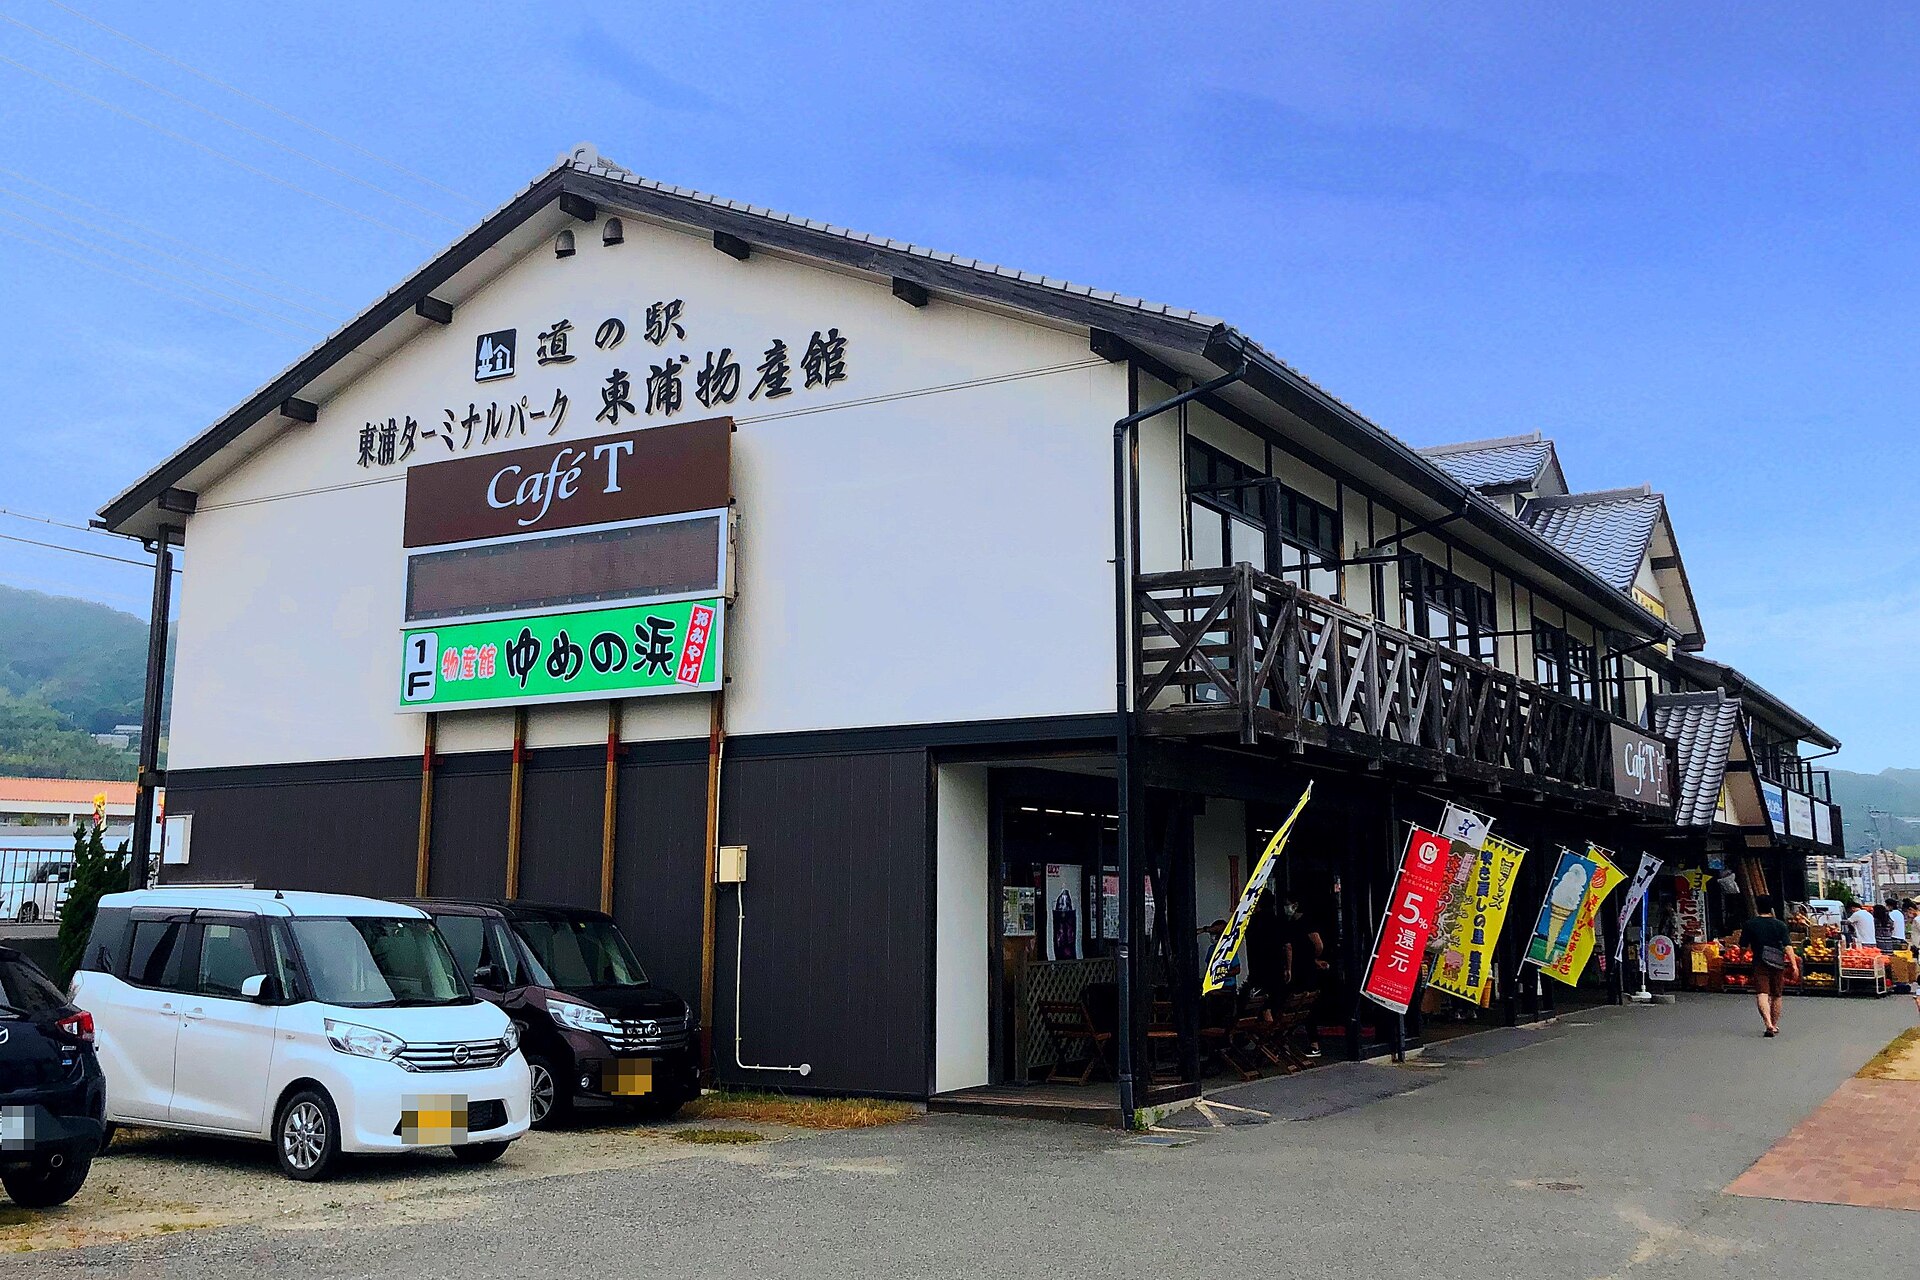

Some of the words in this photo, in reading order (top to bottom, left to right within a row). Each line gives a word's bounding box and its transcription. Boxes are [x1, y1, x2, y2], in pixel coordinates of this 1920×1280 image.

[537, 299, 685, 366] 道の駅
[596, 328, 847, 425] 東浦物産館
[357, 388, 569, 468] 東浦ターミナルパーク
[487, 448, 587, 526] Café
[594, 440, 634, 493] T
[442, 643, 497, 682] 物産館
[505, 615, 676, 689] ゆめの浜
[682, 610, 709, 681] おみやげ
[1625, 740, 1646, 795] Café
[1645, 744, 1655, 783] T
